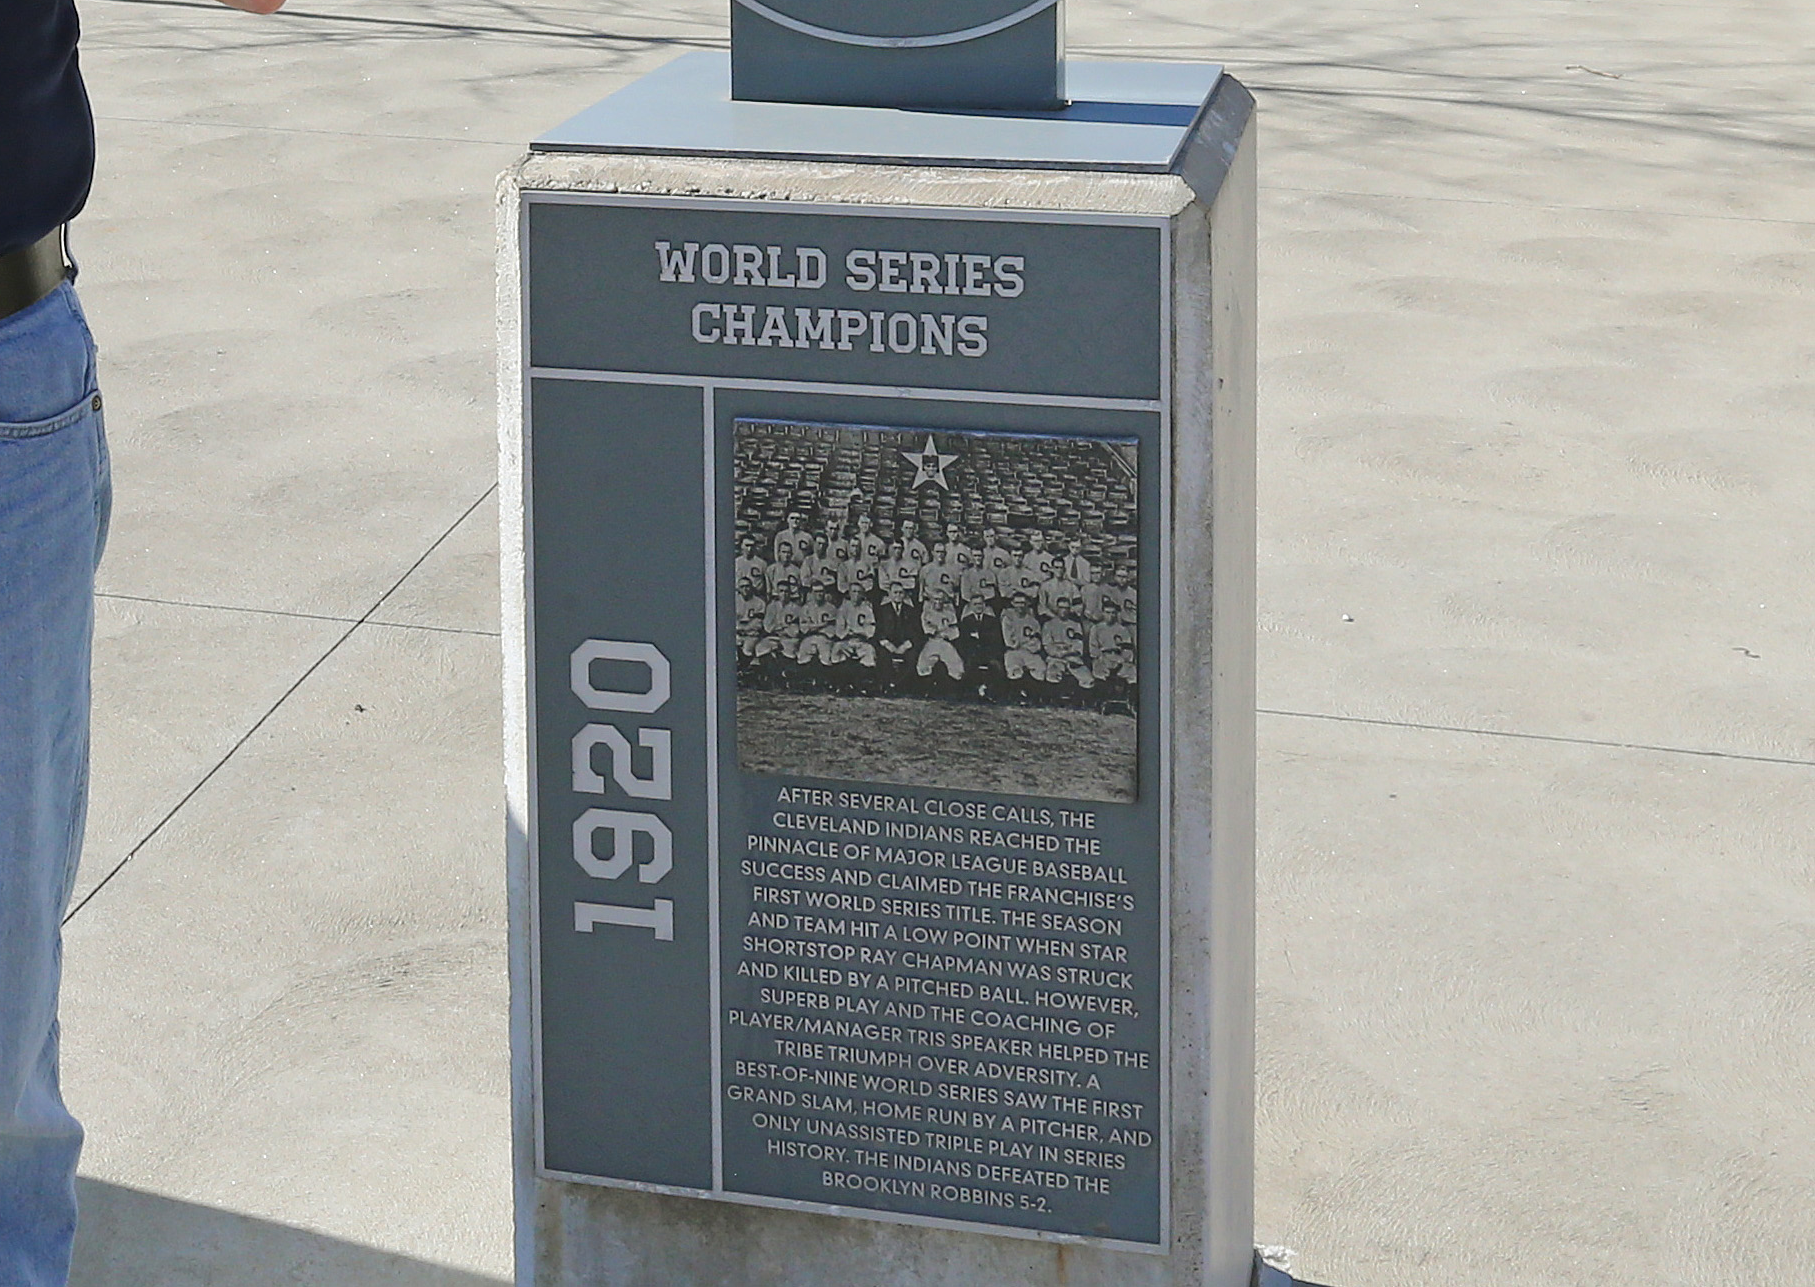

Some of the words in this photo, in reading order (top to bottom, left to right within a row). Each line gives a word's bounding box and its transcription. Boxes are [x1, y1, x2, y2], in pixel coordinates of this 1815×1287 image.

[655, 241, 828, 290] WORLD
[845, 249, 1026, 298] SERIES
[691, 303, 989, 358] CHAMPIONS
[569, 639, 674, 941] 1920
[777, 787, 836, 806] AFTER
[838, 792, 919, 814] SEVERAL
[923, 799, 986, 820] CLOSE
[991, 805, 1054, 827] CALLS,
[1058, 810, 1095, 829] THE
[747, 834, 838, 858] PINNACLE
[842, 843, 870, 861] OF
[875, 846, 946, 868] MAJOR
[951, 853, 1027, 875] LEAGUE
[1032, 860, 1127, 884] BASEBALL
[772, 811, 880, 836] CLEVELAND
[885, 821, 964, 843] INDIANS
[969, 828, 1060, 851] REACHED
[1063, 836, 1100, 855] THE
[740, 859, 825, 882] SUCCESS
[829, 868, 872, 886] AND
[877, 872, 962, 894] CLAIMED
[966, 880, 1002, 899] THE
[1007, 884, 1134, 910] FRANCHISE'S
[753, 885, 801, 905] FIRST
[804, 891, 876, 912] WORLD
[880, 898, 941, 919] SERIES
[944, 904, 996, 924] TITLE.
[1000, 909, 1036, 928] THE
[1040, 913, 1121, 935] SEASON
[742, 936, 855, 960] SHORTSTOP
[859, 946, 897, 965] RAY
[901, 952, 1002, 976] CHAPMAN
[1006, 961, 1051, 981] WAS
[1056, 966, 1133, 989] STRUCK
[747, 911, 789, 929] AND
[793, 915, 845, 935] TEAM
[850, 920, 879, 938] HIT
[883, 924, 897, 941] A
[902, 926, 948, 944] LOW
[953, 930, 1011, 951] POINT
[1015, 936, 1074, 957] WHEN
[1079, 943, 1127, 963] STAR
[736, 960, 778, 978] AND
[783, 965, 842, 985] KILLED
[847, 971, 871, 988] BY
[875, 974, 889, 990] A
[894, 976, 973, 998] PITCHED
[979, 984, 1029, 1005] BALL.
[1035, 991, 1138, 1017] HOWEVER,
[760, 987, 830, 1009] SUPERB
[834, 995, 880, 1014] PLAY
[883, 1001, 925, 1019] AND
[929, 1005, 964, 1024] THE
[970, 1010, 1081, 1035] COACHING
[1086, 1021, 1115, 1039] OF
[728, 1010, 902, 1042] PLAYER/MANAGER
[906, 1028, 945, 1047] TRIS
[950, 1033, 1032, 1057] SPEAKER
[1037, 1042, 1108, 1064] HELPED
[1112, 1050, 1149, 1069] THE
[774, 1039, 823, 1059] TRIBE
[826, 1045, 911, 1068] TRIUMPH
[917, 1055, 969, 1076] OVER
[973, 1062, 1081, 1087] ADVERSITY.
[1085, 1073, 1100, 1090] A
[735, 1060, 857, 1088] BEST-OF-NINE
[861, 1074, 932, 1096] WORLD
[937, 1083, 998, 1104] SERIES
[1003, 1090, 1047, 1109] SAW
[1051, 1095, 1087, 1114] THE
[1092, 1099, 1143, 1119] FIRST
[726, 1085, 796, 1106] GRAND
[801, 1093, 857, 1115] SLAM,
[862, 1100, 921, 1121] HOME
[926, 1107, 966, 1126] RUN
[972, 1112, 996, 1129] BY
[1000, 1115, 1014, 1132] A
[1020, 1117, 1103, 1143] PITCHER,
[1107, 1128, 1151, 1147] AND
